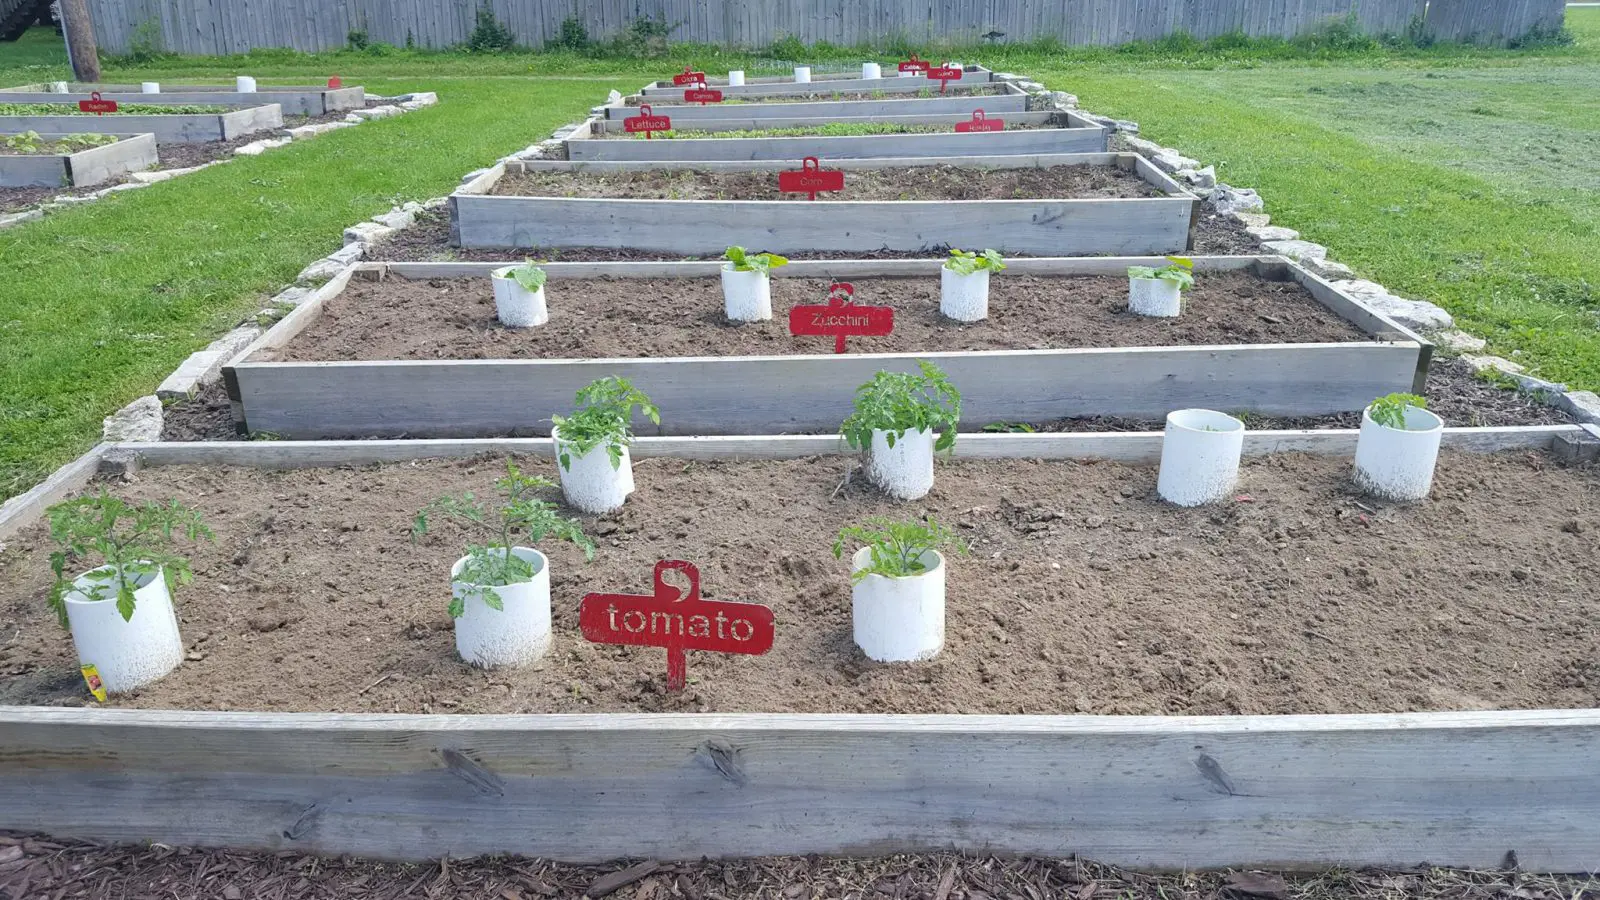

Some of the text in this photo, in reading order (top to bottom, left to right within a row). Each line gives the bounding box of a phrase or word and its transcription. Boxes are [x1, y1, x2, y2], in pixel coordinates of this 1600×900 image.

[631, 120, 666, 130] Lettuce
[800, 177, 823, 186] Corn
[811, 313, 869, 327] Zucchini
[606, 603, 754, 641] tomato
